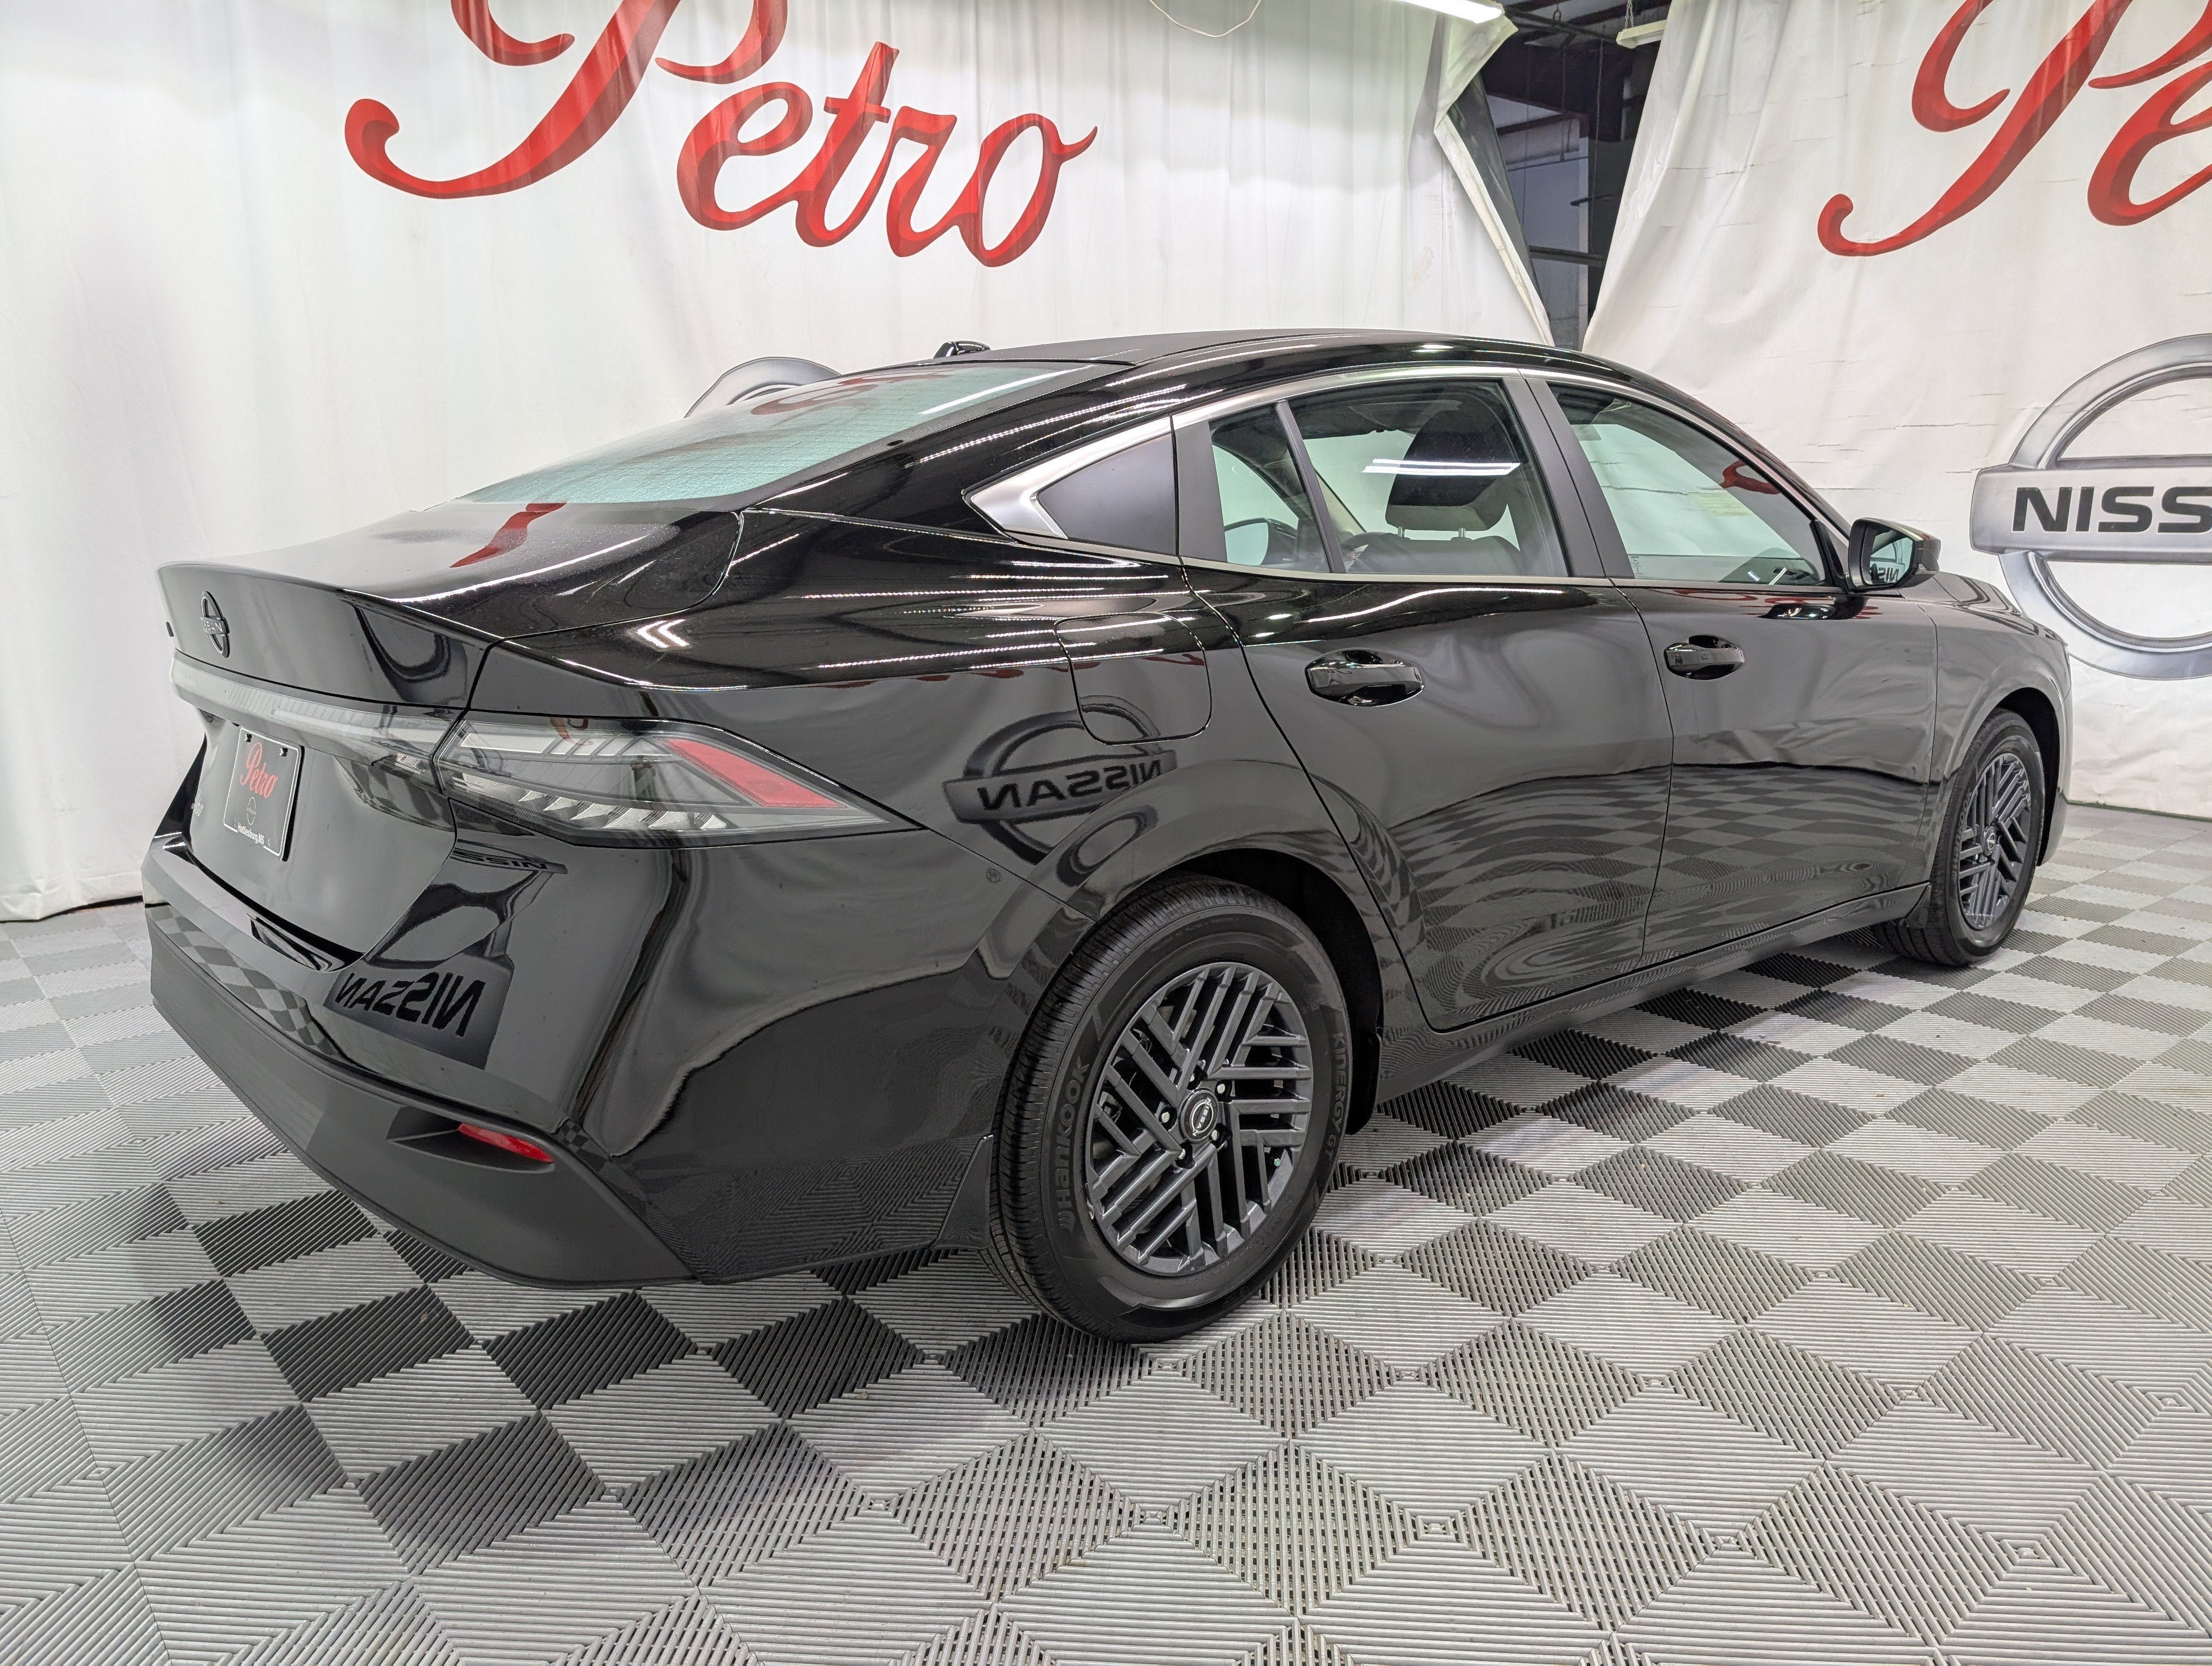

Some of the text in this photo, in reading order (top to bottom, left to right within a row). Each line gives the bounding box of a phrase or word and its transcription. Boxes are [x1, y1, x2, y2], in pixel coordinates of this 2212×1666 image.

[345, 0, 1098, 267] Petro
[240, 742, 279, 798] Petro
[1192, 1097, 1212, 1137] NISSAN
